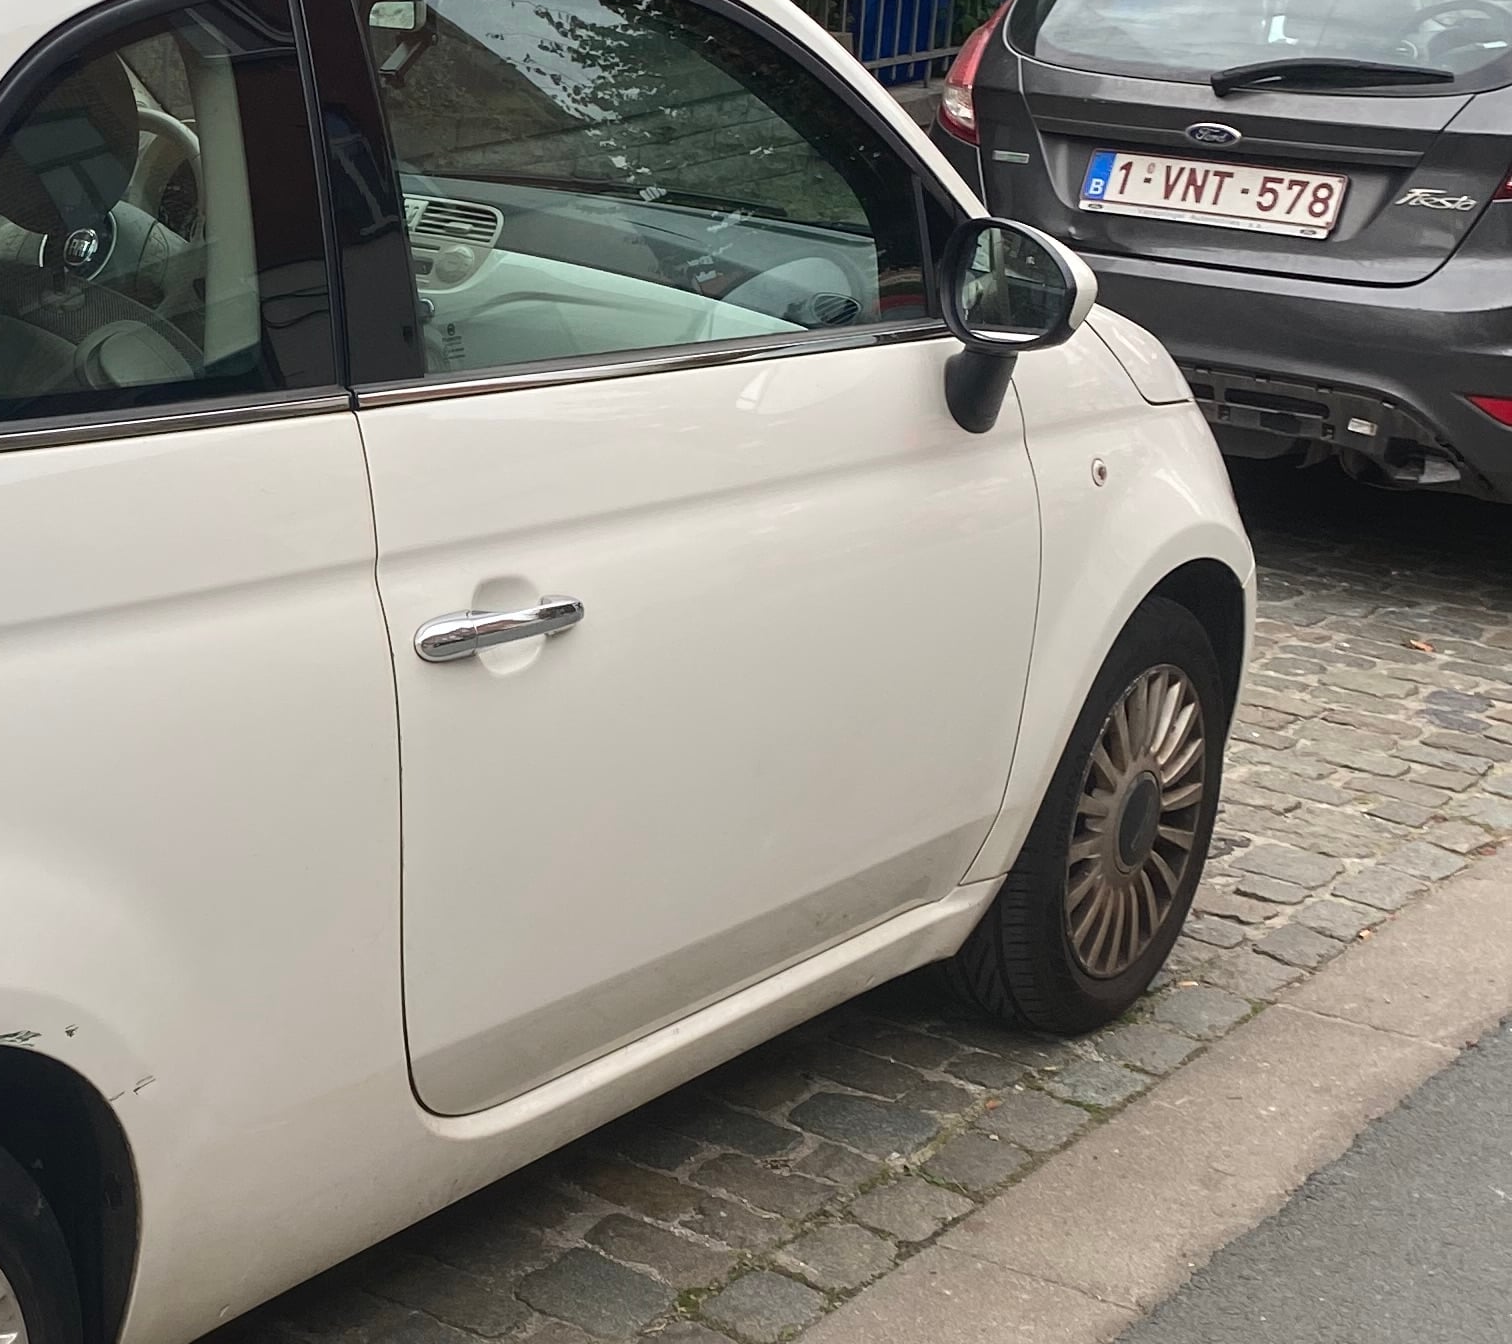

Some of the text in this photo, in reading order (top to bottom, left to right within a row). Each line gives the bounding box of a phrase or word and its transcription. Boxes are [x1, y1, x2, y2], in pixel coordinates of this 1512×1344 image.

[1195, 127, 1229, 143] Ford
[1088, 178, 1104, 195] B
[1394, 188, 1477, 211] Fiesta
